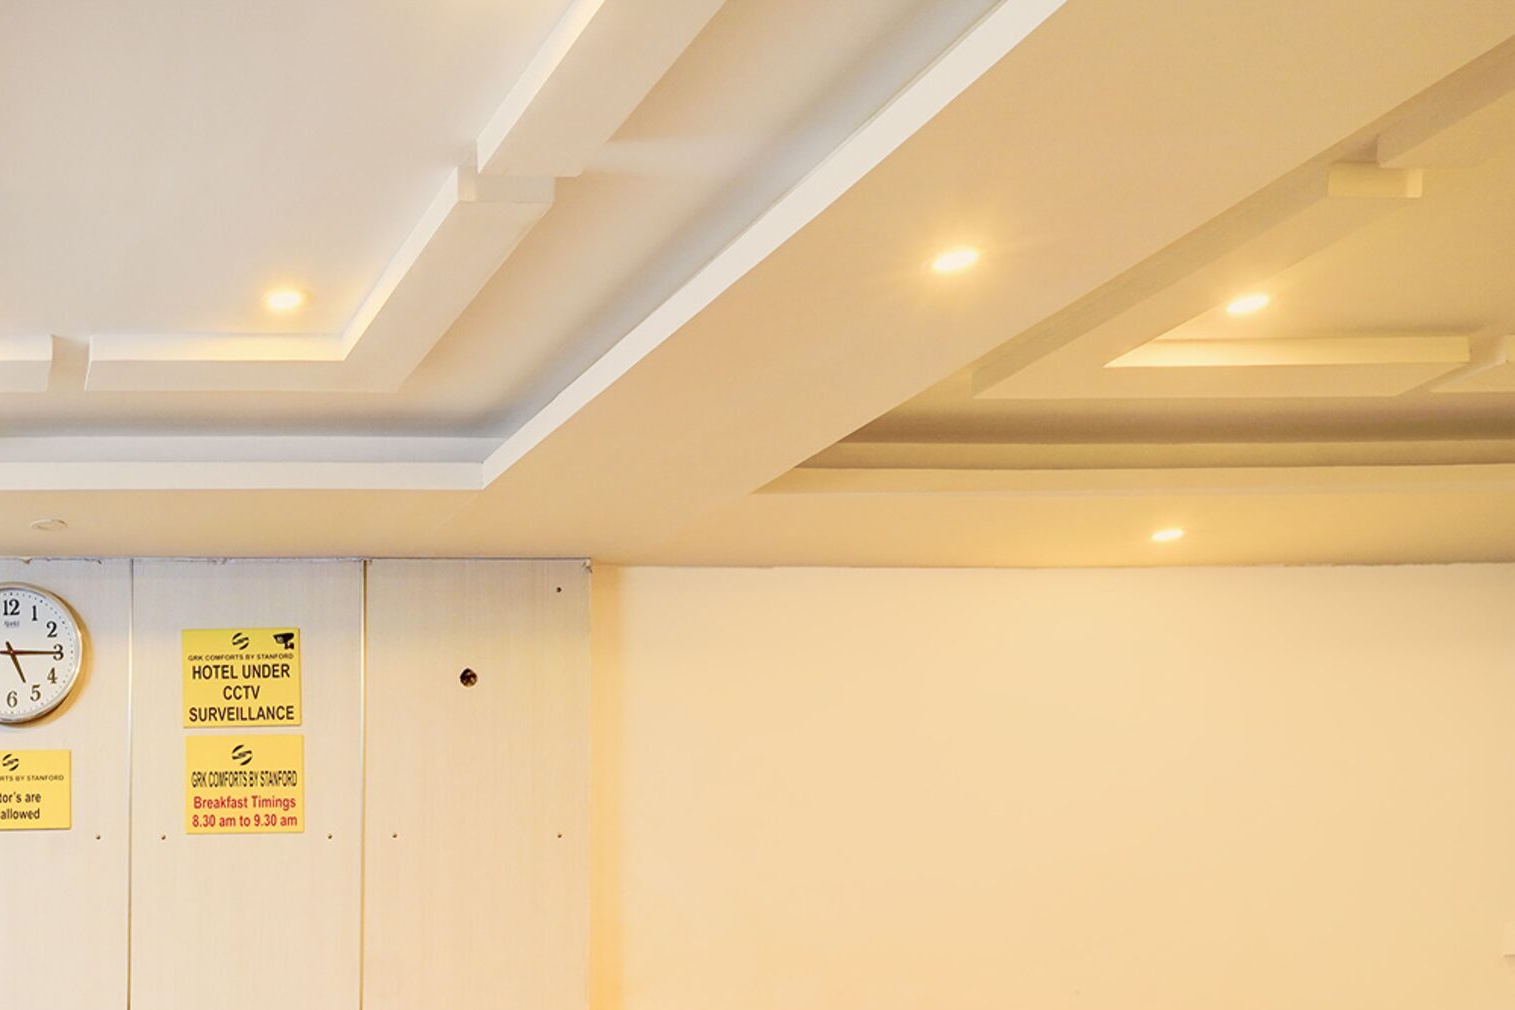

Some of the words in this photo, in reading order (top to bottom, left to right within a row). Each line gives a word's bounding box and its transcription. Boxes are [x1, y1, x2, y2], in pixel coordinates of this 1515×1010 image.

[3, 599, 20, 616] 12
[32, 605, 38, 621] 1
[46, 621, 58, 638] 2
[53, 644, 64, 661] 3
[47, 667, 58, 684] 4
[192, 665, 238, 679] HOTEL
[242, 664, 290, 679] UNDER
[6, 690, 18, 707] 6
[30, 684, 41, 701] 5
[223, 685, 260, 700] CCTV
[189, 706, 294, 722] SURVEILLANCE
[191, 772, 207, 788] GRK
[208, 771, 247, 788] COMFORTS
[249, 771, 259, 787] BY
[260, 770, 298, 787] STANFORD
[25, 793, 42, 803] are
[193, 796, 248, 809] Breakfast
[251, 795, 296, 811] Timings
[0, 808, 41, 820] allowed
[192, 815, 216, 827] 8.30
[219, 816, 236, 827] am
[239, 815, 251, 827] to
[254, 813, 277, 827] 9.30
[280, 815, 298, 827] am
